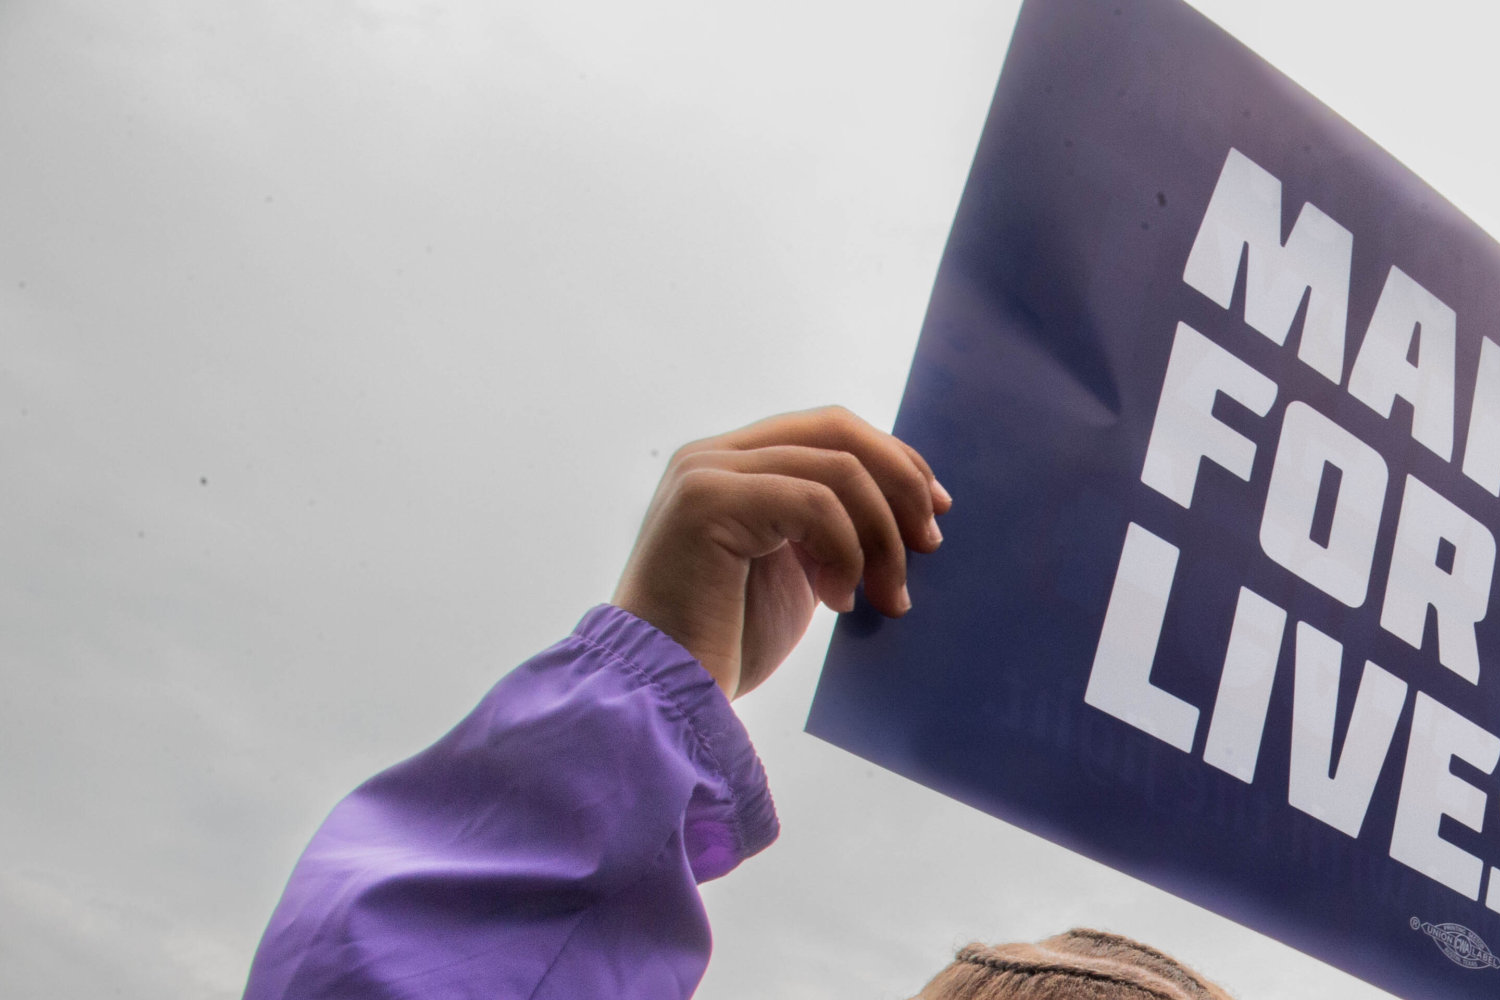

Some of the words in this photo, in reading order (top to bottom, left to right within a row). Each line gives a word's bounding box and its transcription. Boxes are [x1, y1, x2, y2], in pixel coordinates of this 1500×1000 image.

[1141, 321, 1496, 685] FOR
[1426, 925, 1453, 945] UNION
[1471, 946, 1498, 967] LABEL
